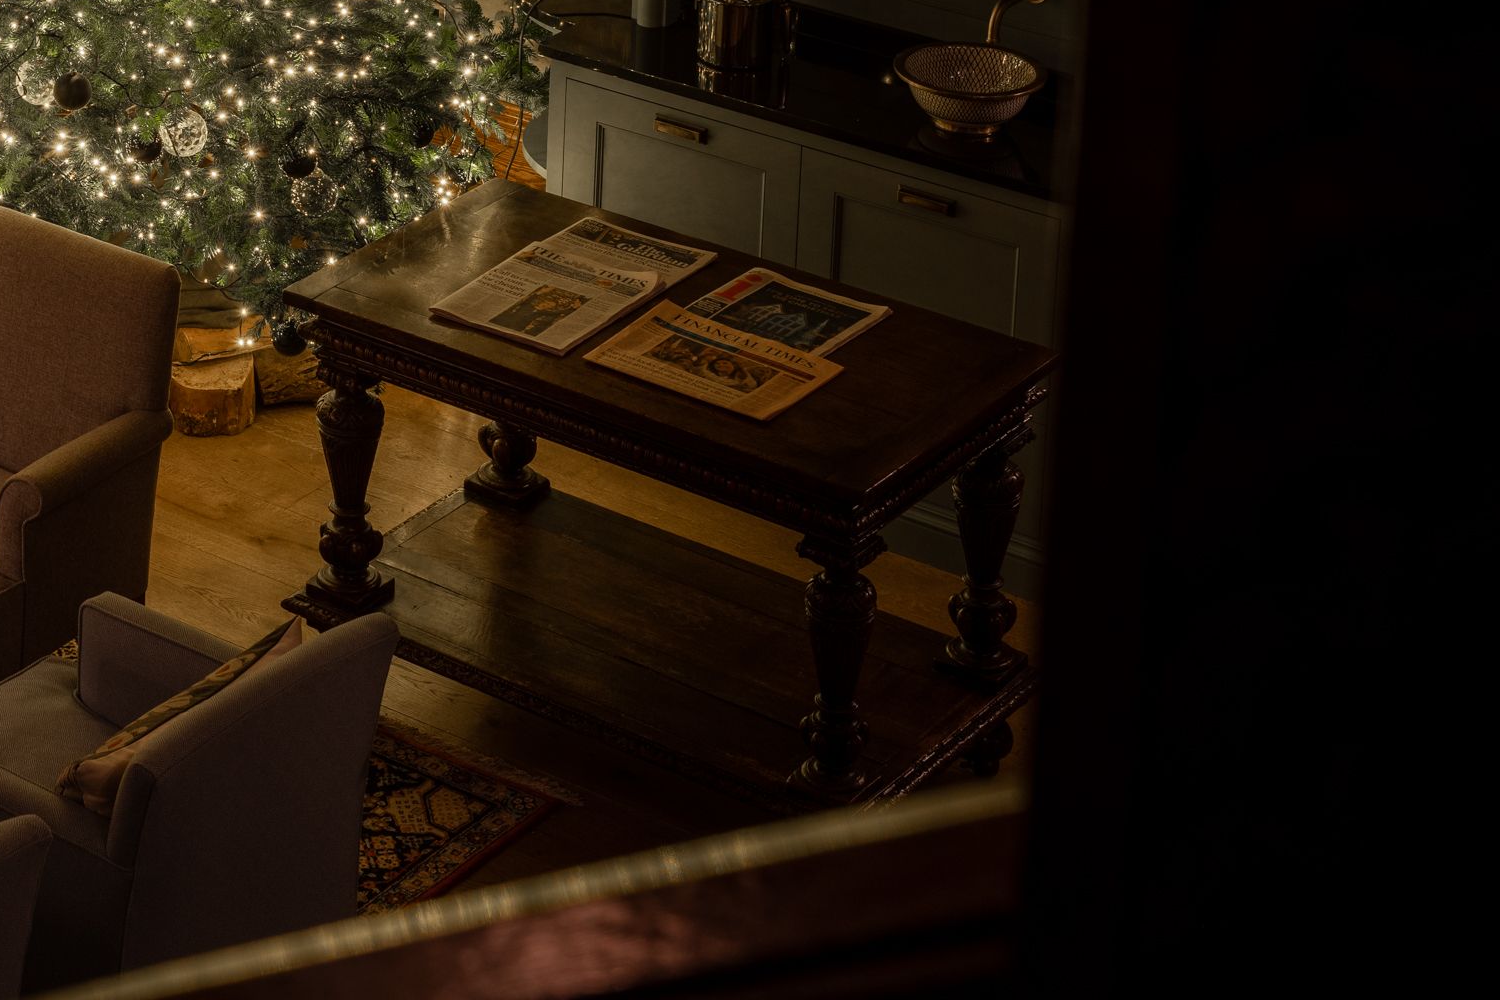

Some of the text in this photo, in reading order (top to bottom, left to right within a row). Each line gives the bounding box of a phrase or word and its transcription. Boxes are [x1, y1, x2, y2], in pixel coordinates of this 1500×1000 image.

[531, 246, 565, 262] THE
[599, 269, 649, 288] TIMES
[617, 243, 689, 268] Guardian
[714, 274, 763, 302] i
[673, 313, 758, 350] FINANCIAL
[764, 346, 818, 369] TIMES
